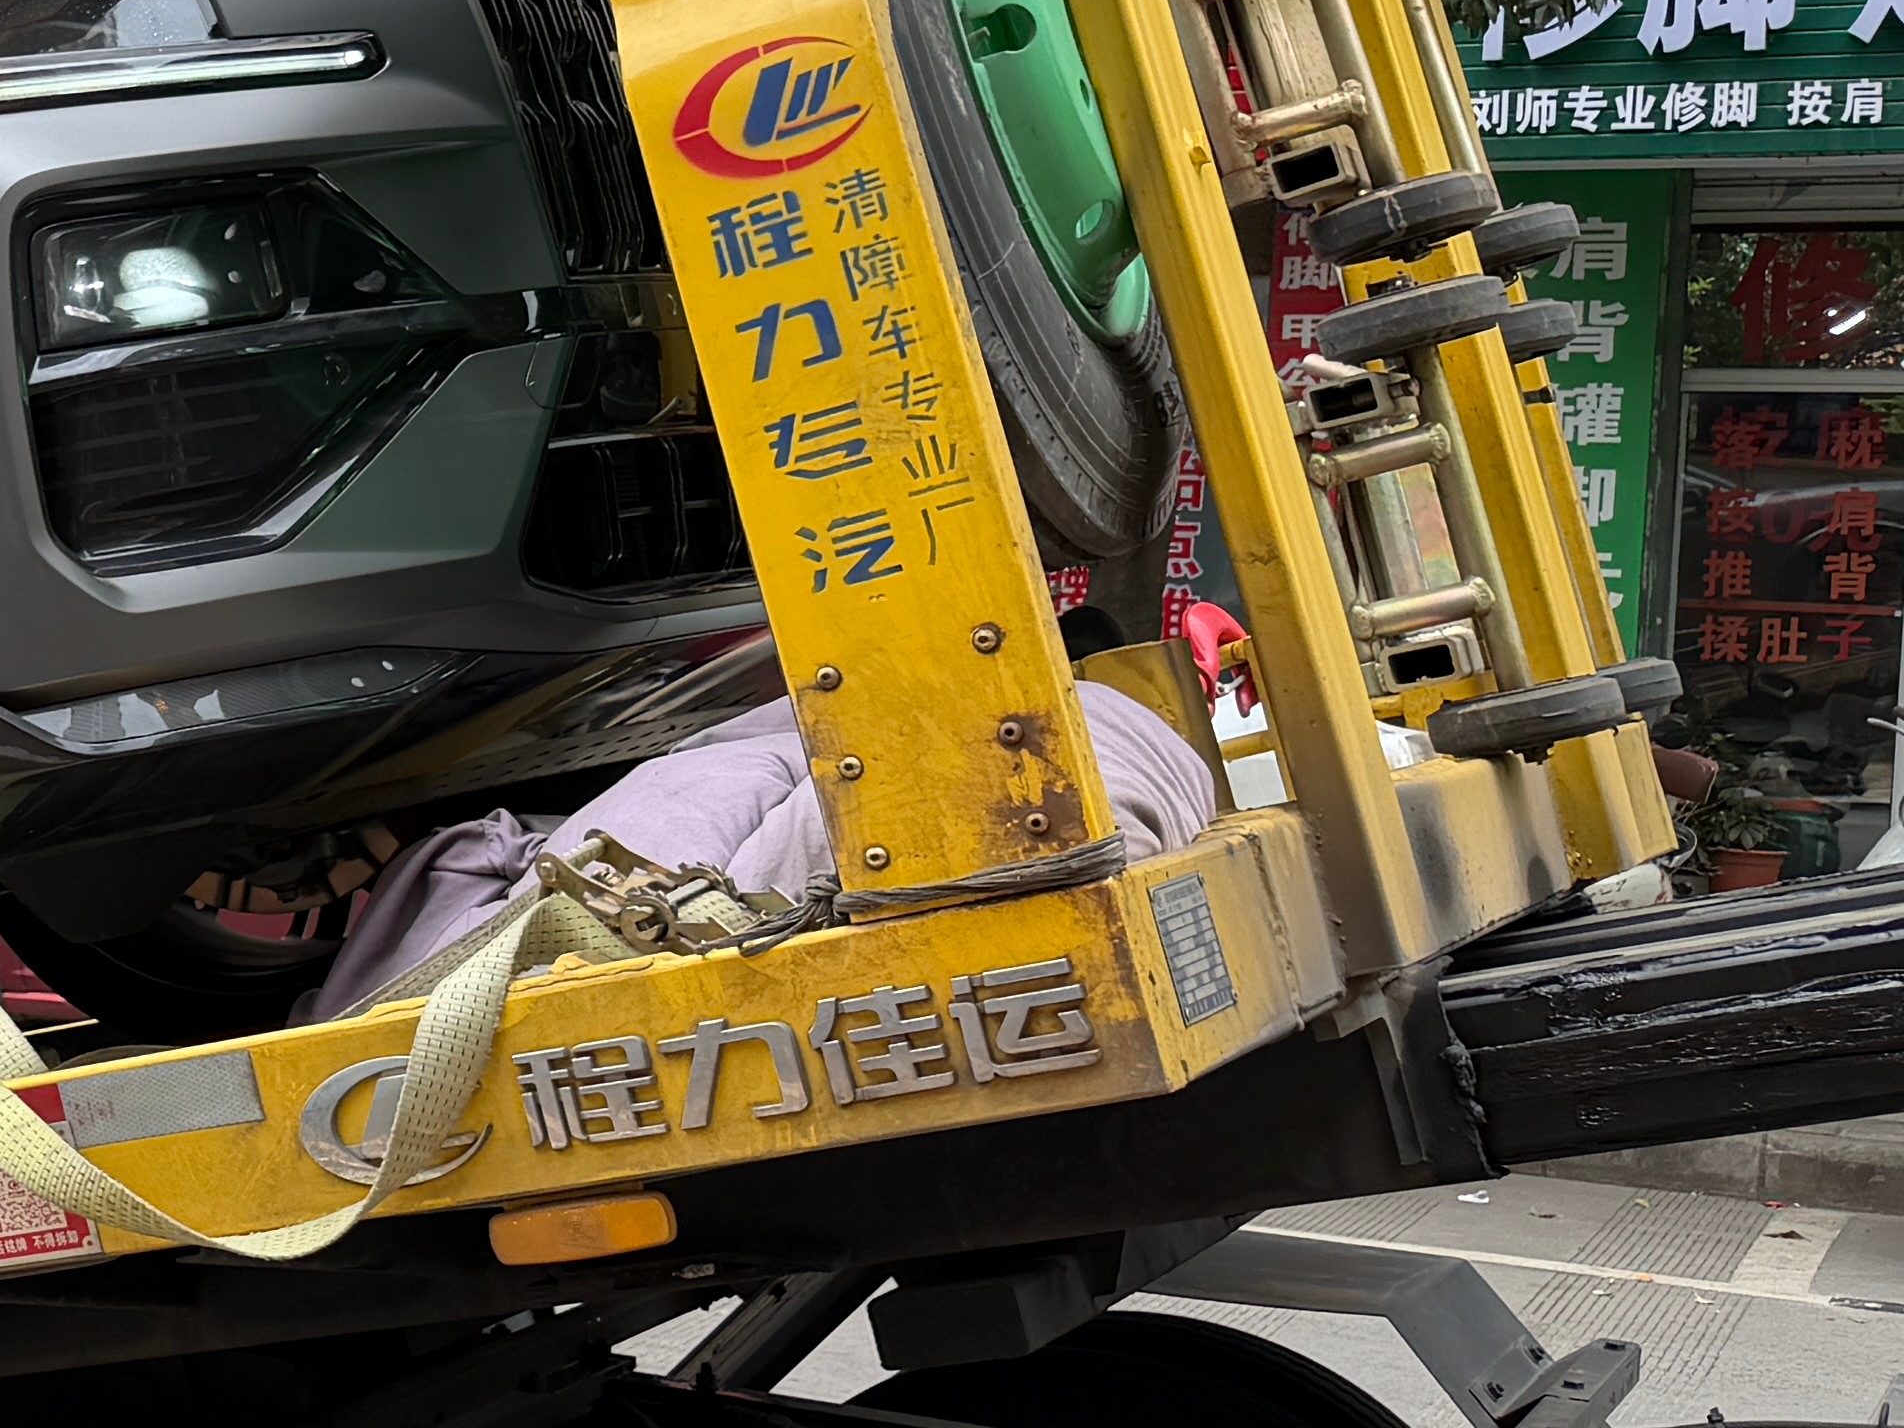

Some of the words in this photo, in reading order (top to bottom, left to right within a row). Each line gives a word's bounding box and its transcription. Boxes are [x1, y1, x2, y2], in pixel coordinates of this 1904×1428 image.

[1471, 81, 1758, 136] 刘师专业修脚
[1786, 78, 1883, 126] 按肩
[708, 190, 903, 594] 程力专汽
[824, 168, 975, 566] 清障车专业厂
[1698, 615, 1873, 663] 揉肚子
[510, 956, 1104, 1152] 程力佳运
